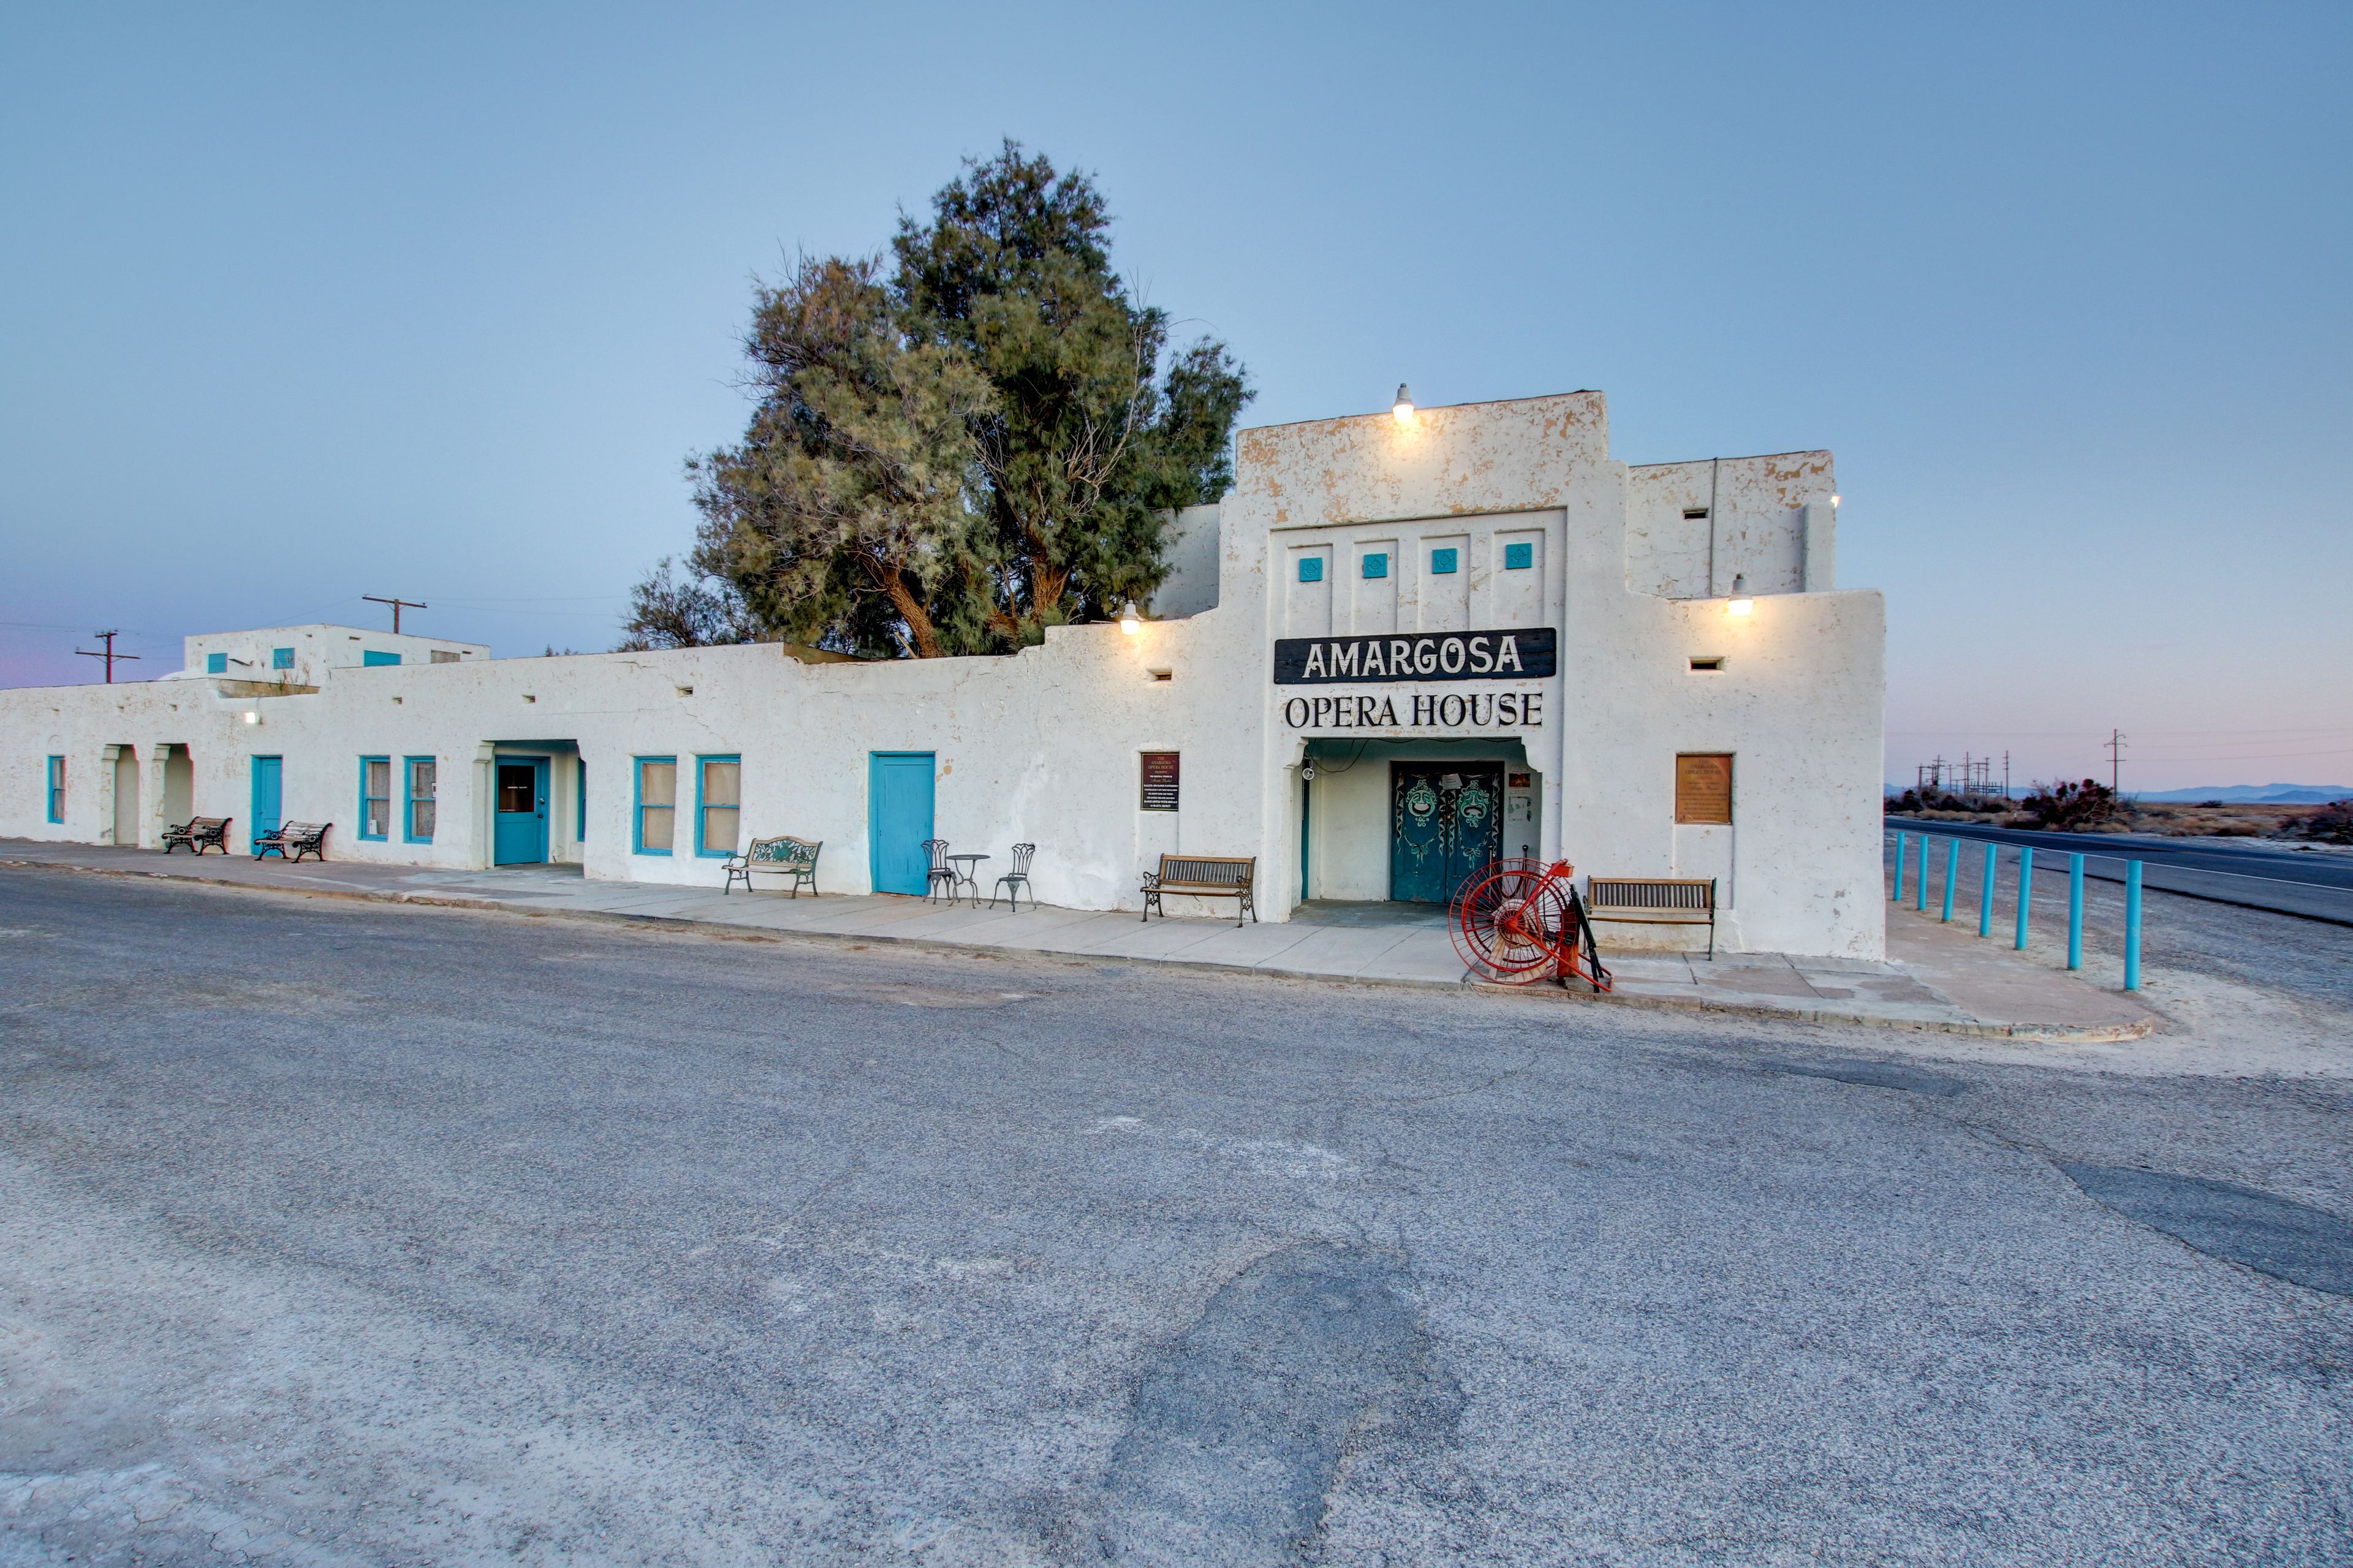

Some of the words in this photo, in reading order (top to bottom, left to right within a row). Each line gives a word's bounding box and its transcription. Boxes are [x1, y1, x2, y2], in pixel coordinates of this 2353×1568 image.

[1302, 635, 1524, 679] AMARGOSA
[1286, 694, 1401, 729] OPERA
[1411, 691, 1544, 727] HOUSE
